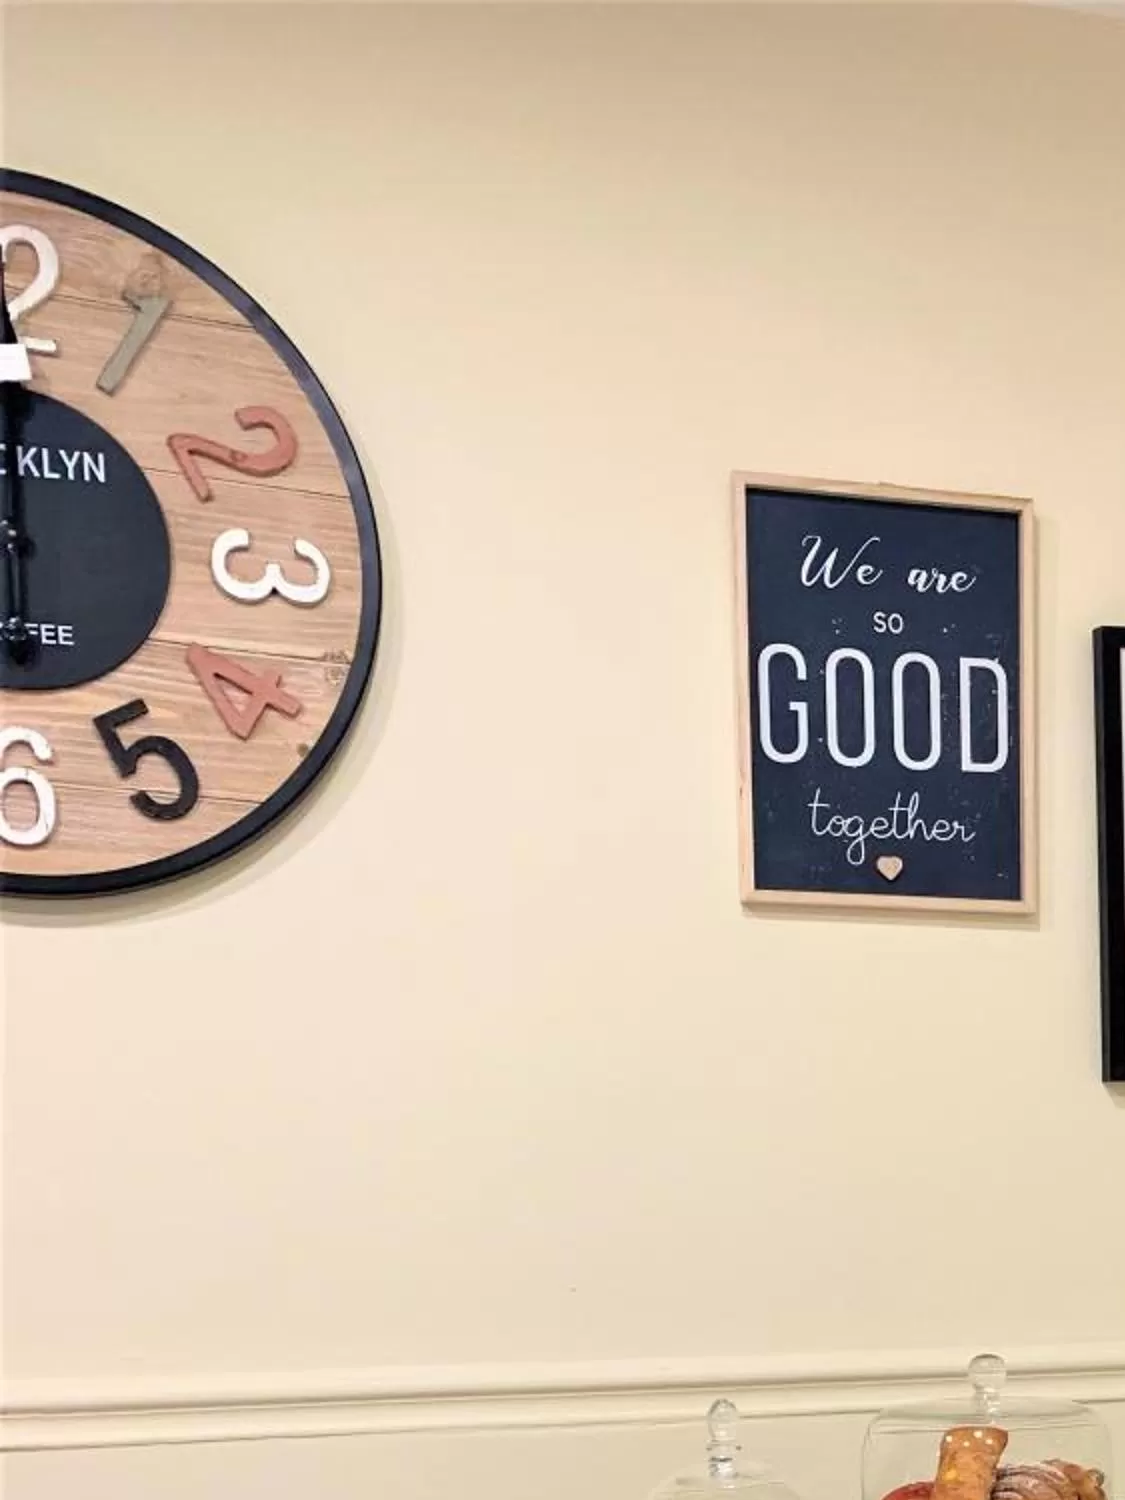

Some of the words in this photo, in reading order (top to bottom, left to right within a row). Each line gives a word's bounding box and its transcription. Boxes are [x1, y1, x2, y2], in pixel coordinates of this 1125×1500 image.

[97, 288, 173, 397] 1
[167, 406, 298, 503] 2
[210, 528, 331, 605] 3
[800, 535, 882, 589] We
[907, 567, 976, 593] are
[0, 622, 75, 646] FEE
[186, 642, 302, 741] 4
[758, 643, 1008, 773] GOOD
[0, 726, 57, 847] 6
[94, 699, 199, 822] 5
[808, 788, 976, 865] together
